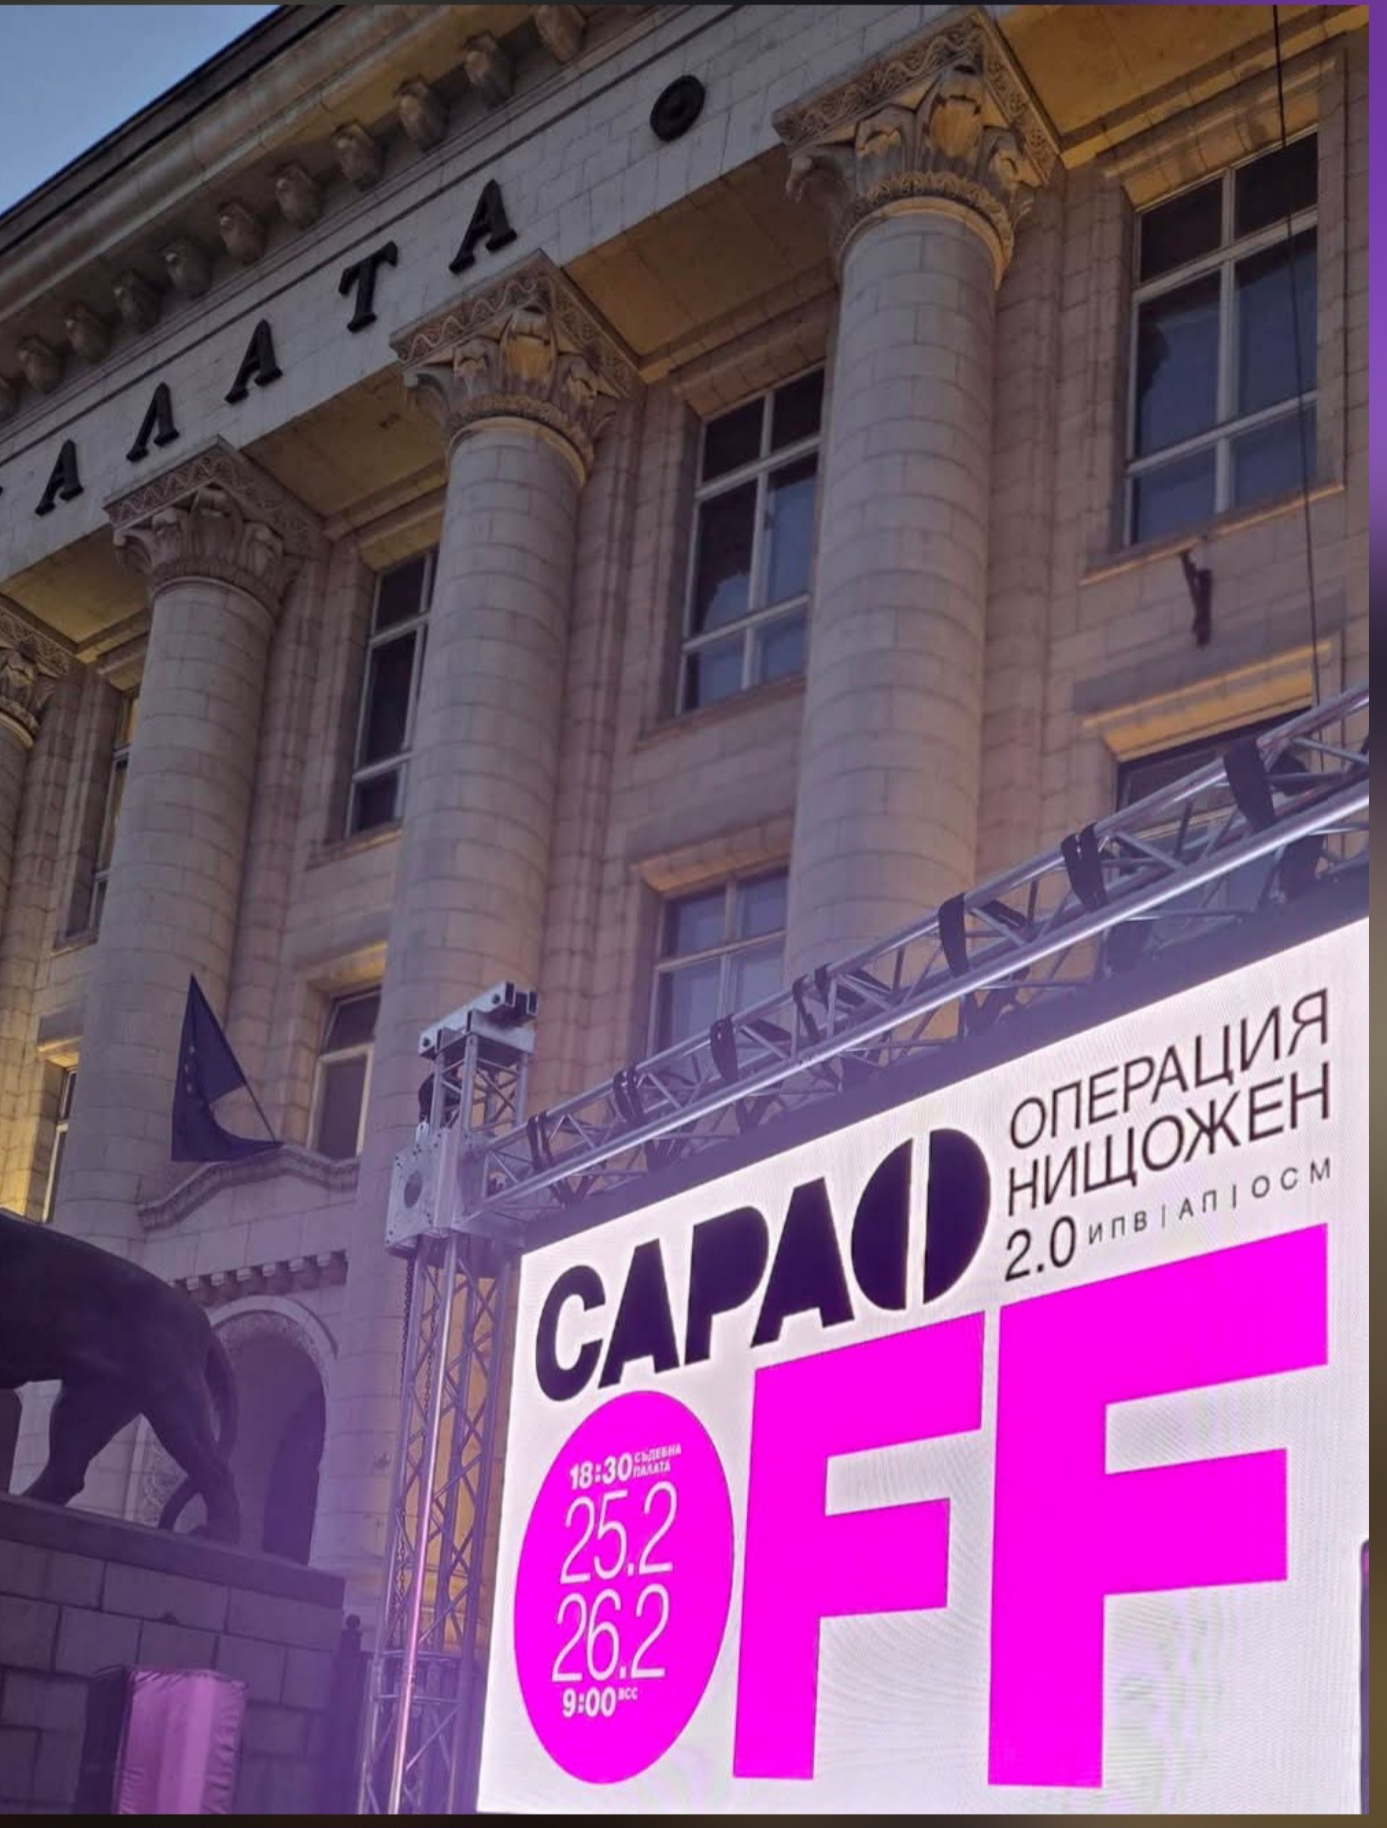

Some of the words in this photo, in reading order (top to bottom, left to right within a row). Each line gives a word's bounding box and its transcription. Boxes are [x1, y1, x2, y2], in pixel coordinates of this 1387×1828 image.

[1010, 988, 1328, 1150] ОПЕРАЦИЯ
[1007, 1062, 1329, 1217] НИЩОЖЕН
[534, 1127, 992, 1402] САРАФ
[1005, 1216, 1077, 1282] 2.0
[513, 1222, 1329, 1790] OFF
[569, 1453, 633, 1491] 18:30
[634, 1443, 682, 1464] СЪДЕБНА
[632, 1460, 671, 1478] ПАЛАТА
[560, 1481, 678, 1584] 25.2
[552, 1583, 670, 1682] 26.2
[563, 1687, 616, 1718] 9:00
